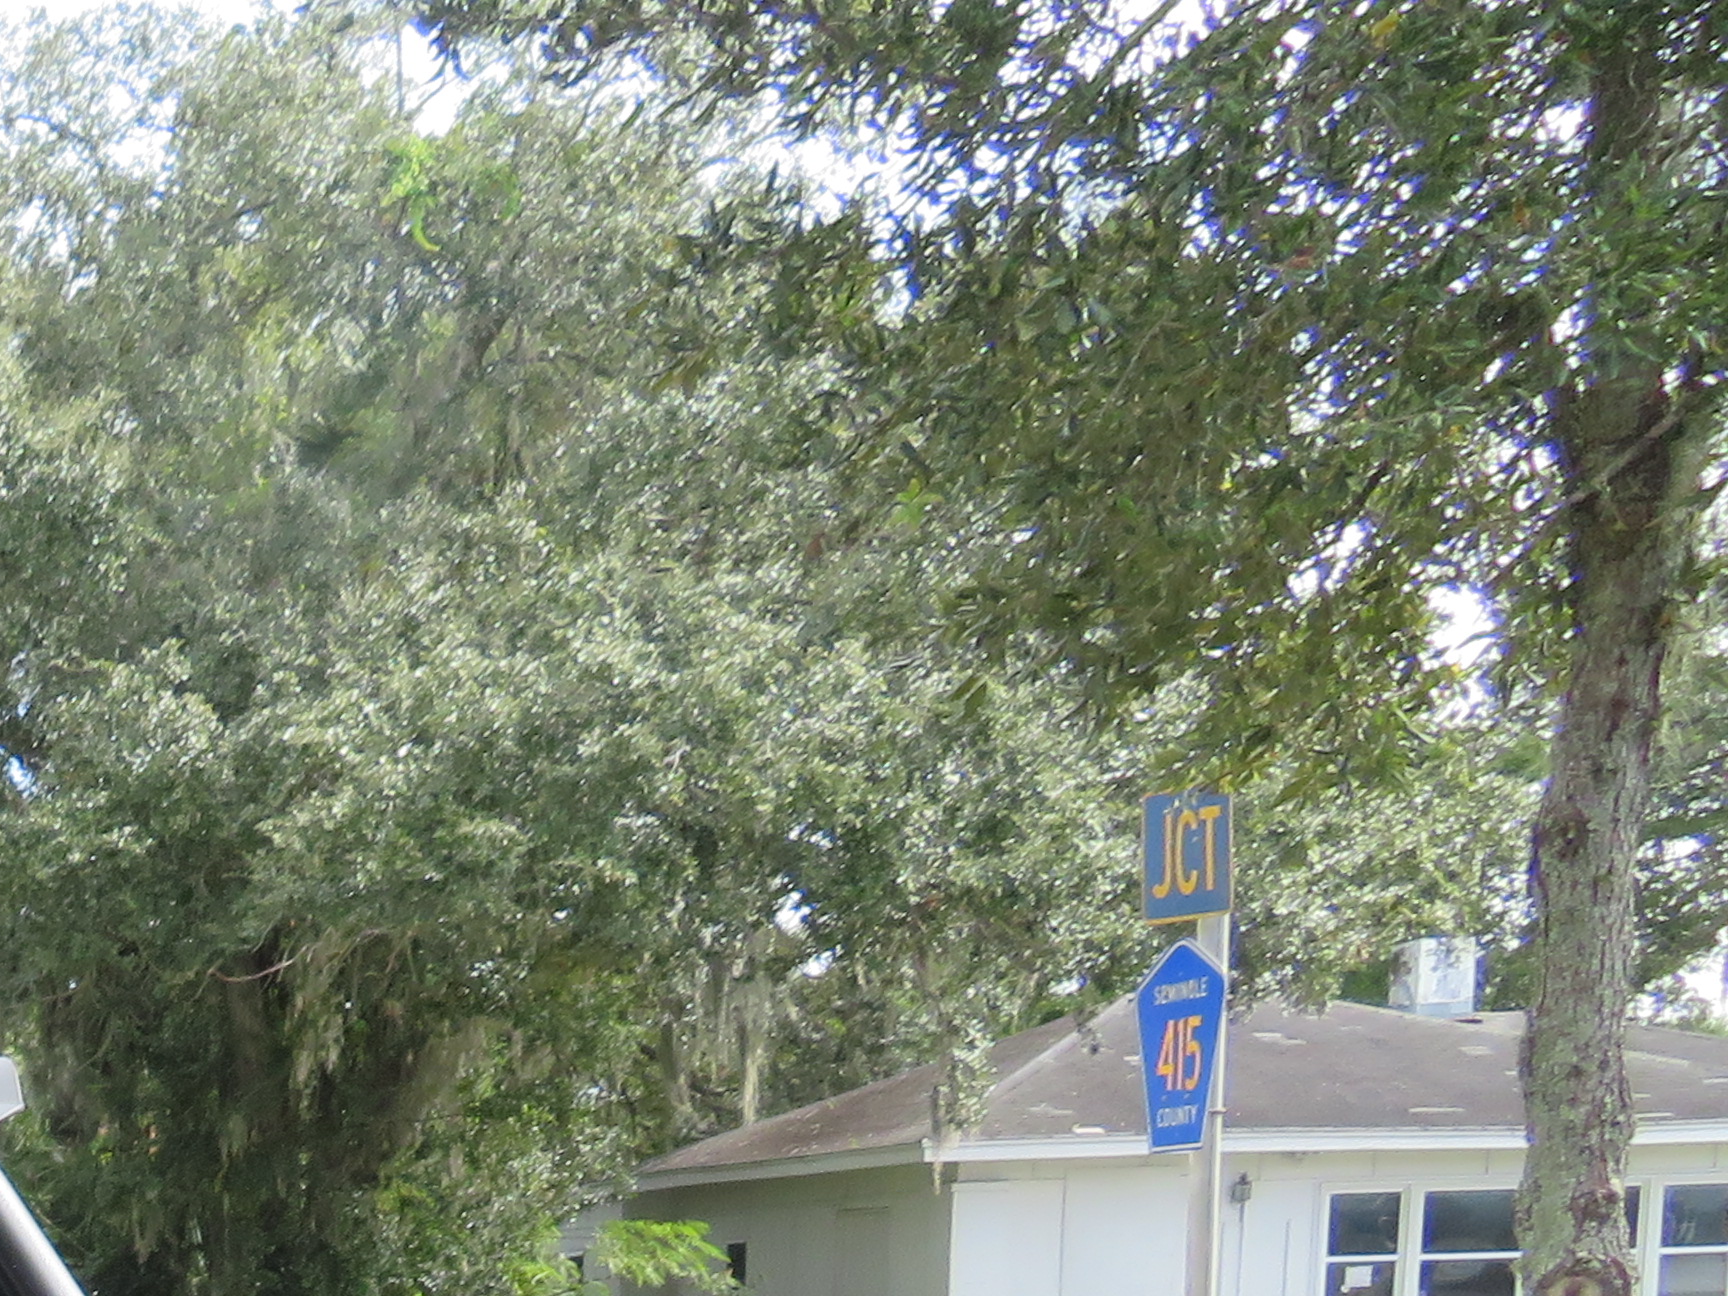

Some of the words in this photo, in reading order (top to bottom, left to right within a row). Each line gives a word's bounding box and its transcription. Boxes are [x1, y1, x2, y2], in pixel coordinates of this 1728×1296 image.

[1152, 805, 1221, 898] JCT
[1156, 1015, 1203, 1091] 415
[1157, 1104, 1199, 1127] COUNTY
